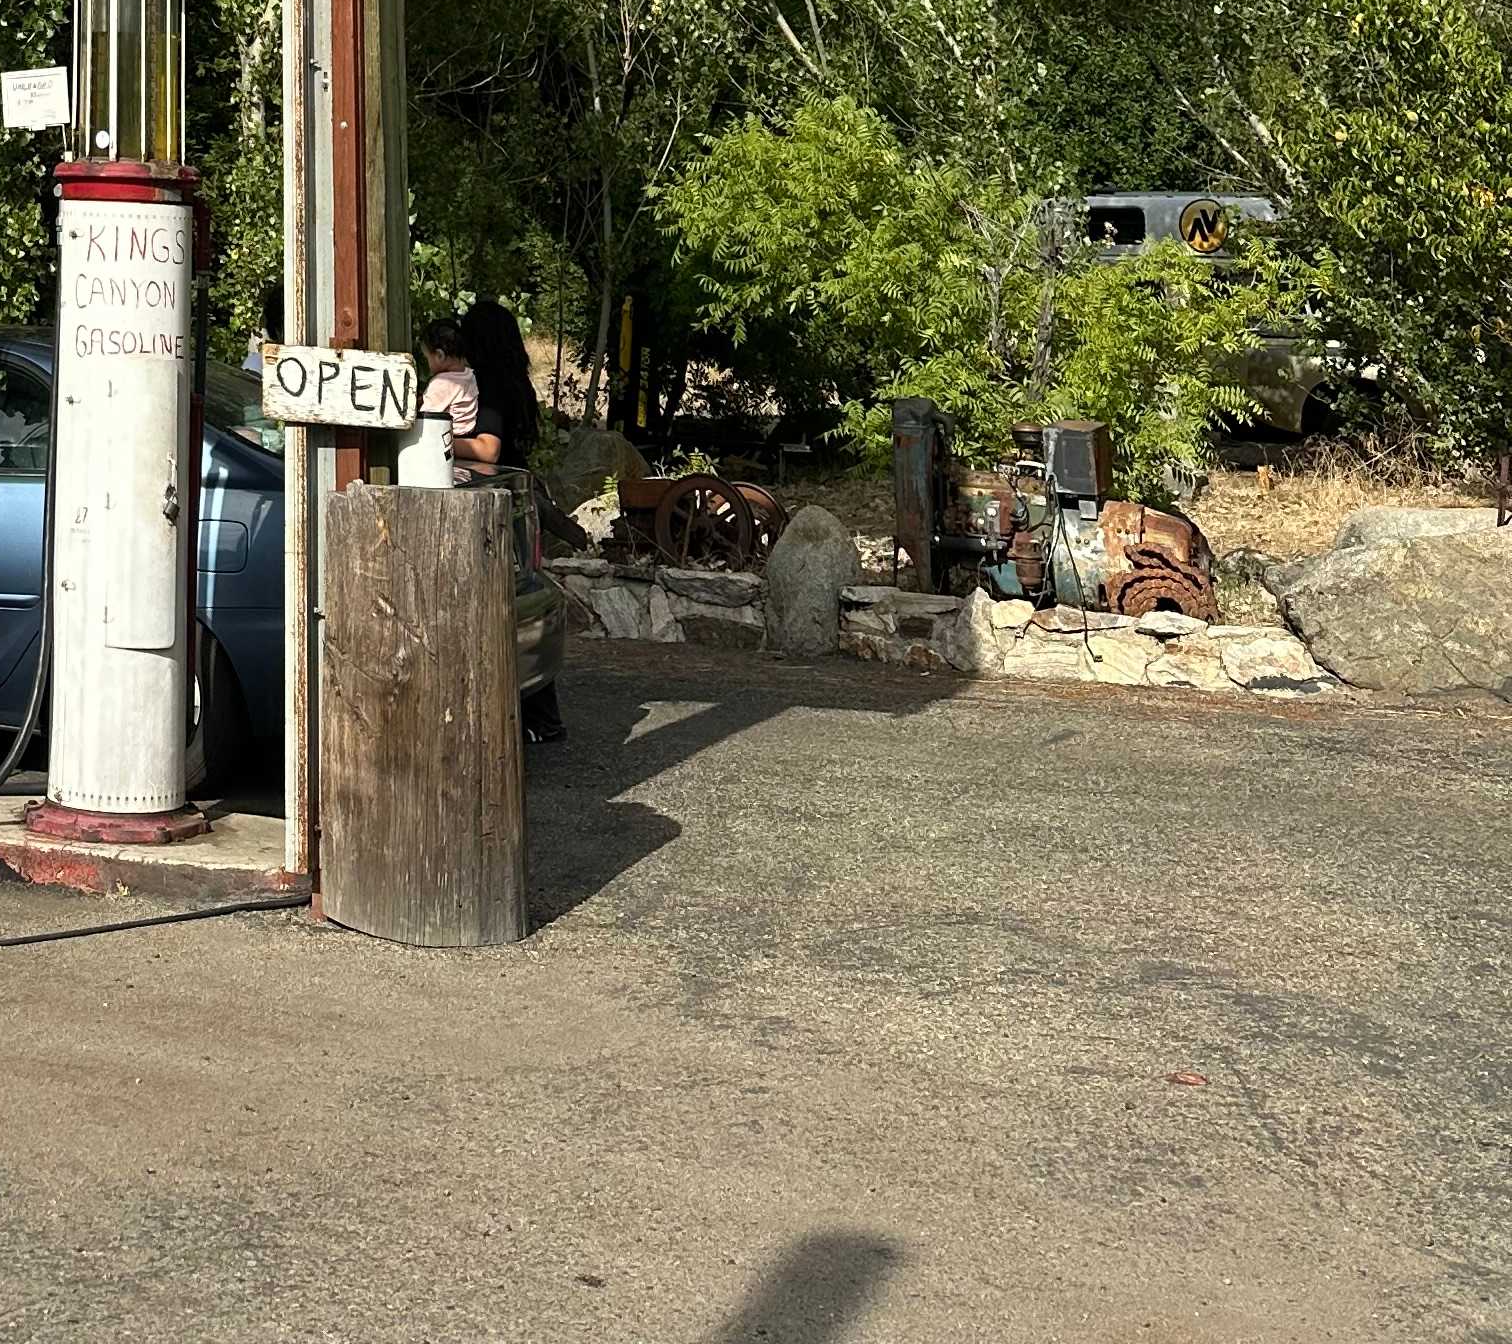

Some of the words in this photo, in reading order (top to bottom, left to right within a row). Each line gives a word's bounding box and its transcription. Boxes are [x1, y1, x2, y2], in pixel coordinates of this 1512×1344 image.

[86, 224, 185, 265] KINGS
[75, 273, 176, 310] CANYON
[75, 324, 184, 360] GASOLINE
[276, 357, 411, 421] OPEN
